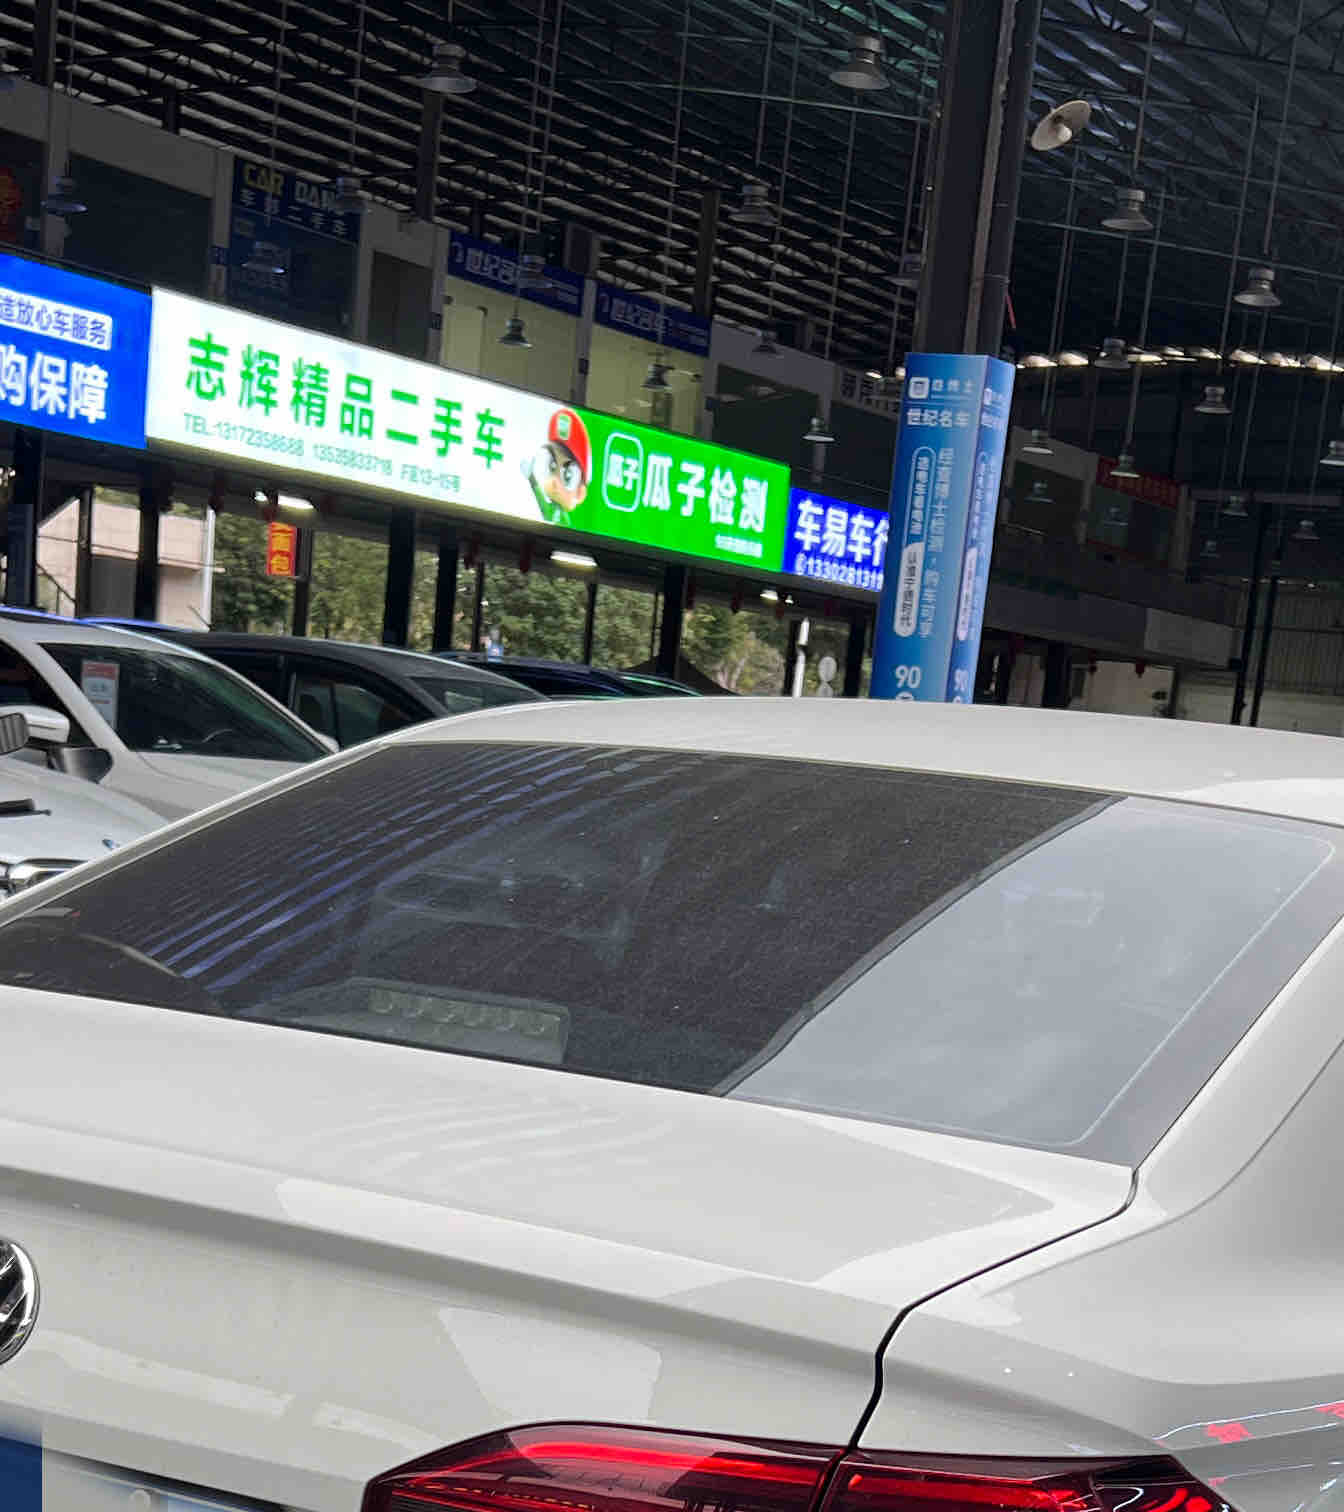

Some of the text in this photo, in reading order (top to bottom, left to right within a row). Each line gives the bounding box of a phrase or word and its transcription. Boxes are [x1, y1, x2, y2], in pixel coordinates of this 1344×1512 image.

[186, 333, 507, 470] 志辉精品二手车
[643, 452, 769, 533] 瓜子检测
